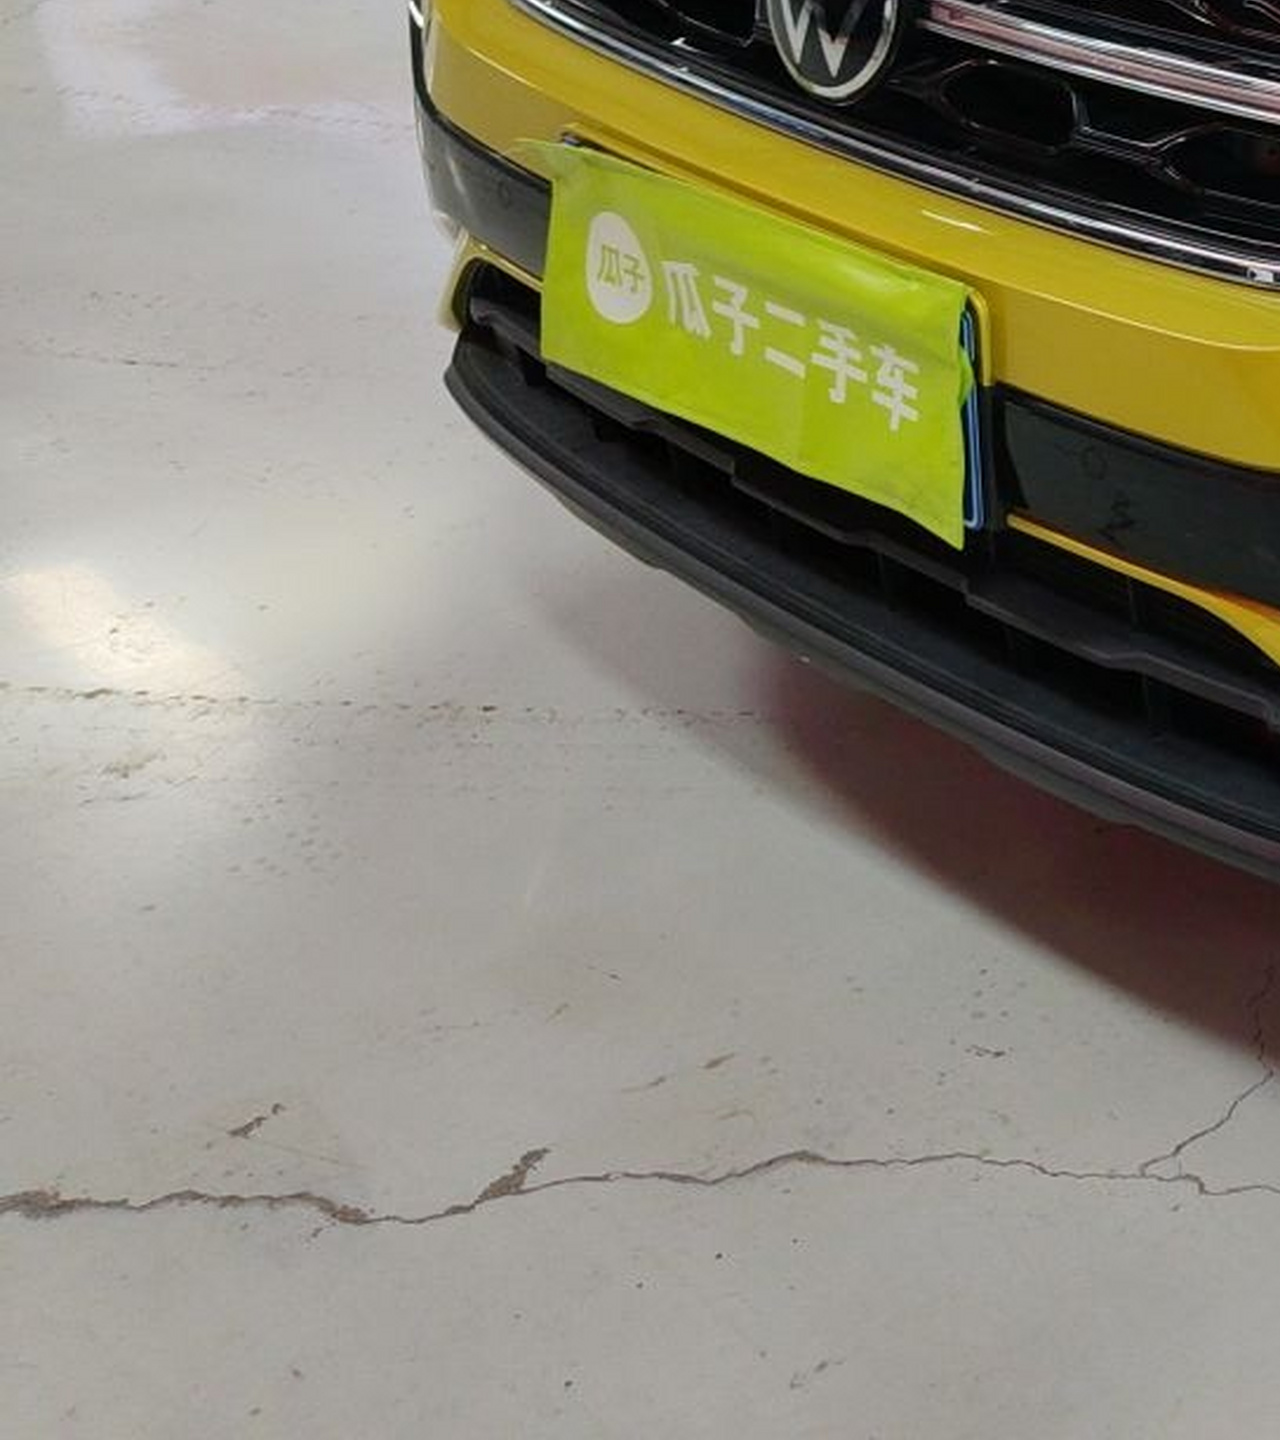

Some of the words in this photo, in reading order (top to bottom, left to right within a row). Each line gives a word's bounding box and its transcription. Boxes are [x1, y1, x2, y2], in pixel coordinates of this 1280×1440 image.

[599, 244, 645, 294] 瓜子
[662, 260, 919, 431] 瓜子二手车
